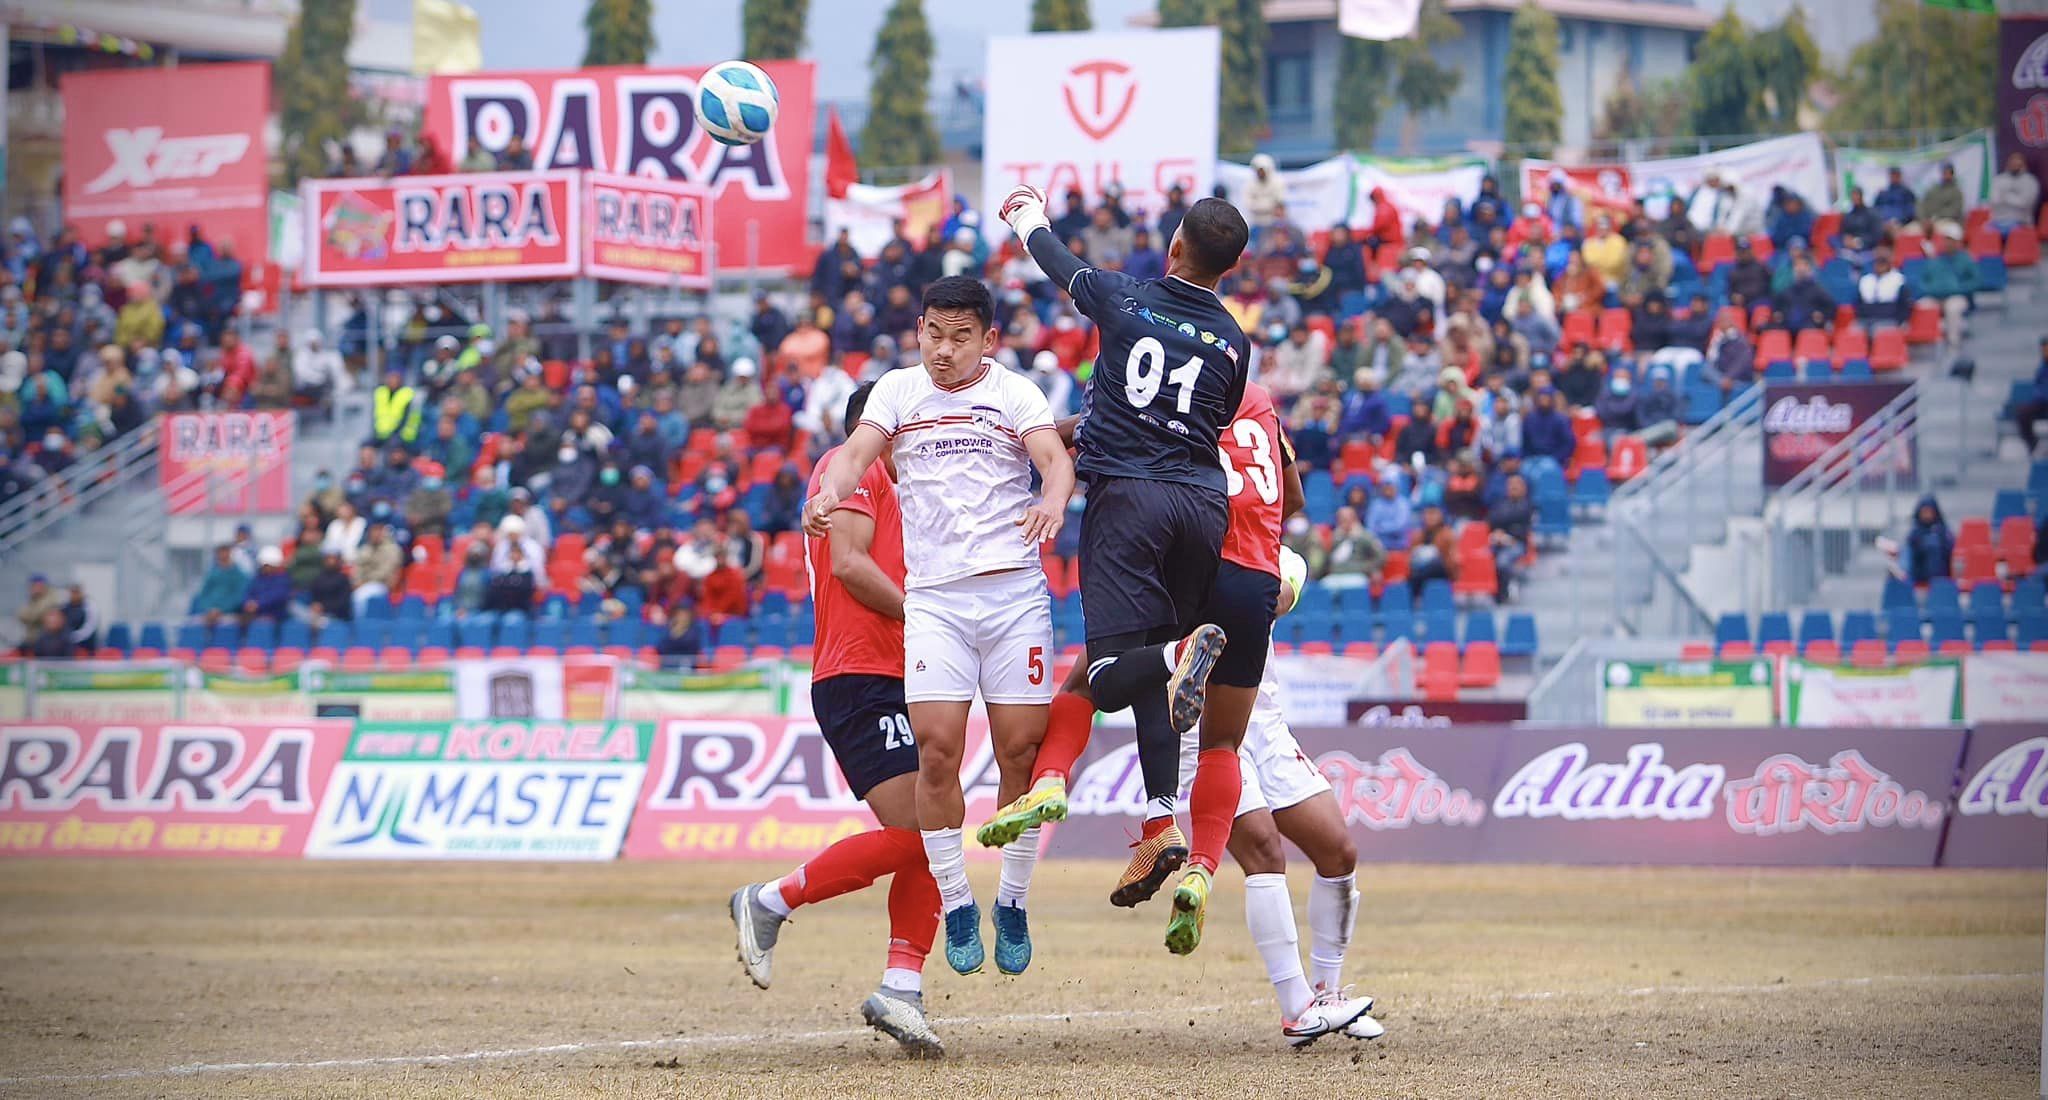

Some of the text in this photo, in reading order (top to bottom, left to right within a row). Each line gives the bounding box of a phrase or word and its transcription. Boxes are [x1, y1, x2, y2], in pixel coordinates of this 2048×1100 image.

[394, 183, 560, 252] RARA
[594, 188, 703, 246] RARA
[1124, 336, 1204, 413] 91
[171, 414, 280, 460] RARA
[935, 438, 993, 450] API POWER
[936, 449, 967, 458] COMPANY
[1027, 646, 1044, 686] 5
[443, 723, 638, 759] KOREA
[879, 713, 914, 750] 29
[0, 726, 313, 812] RARA
[1493, 743, 1725, 818] Aaha
